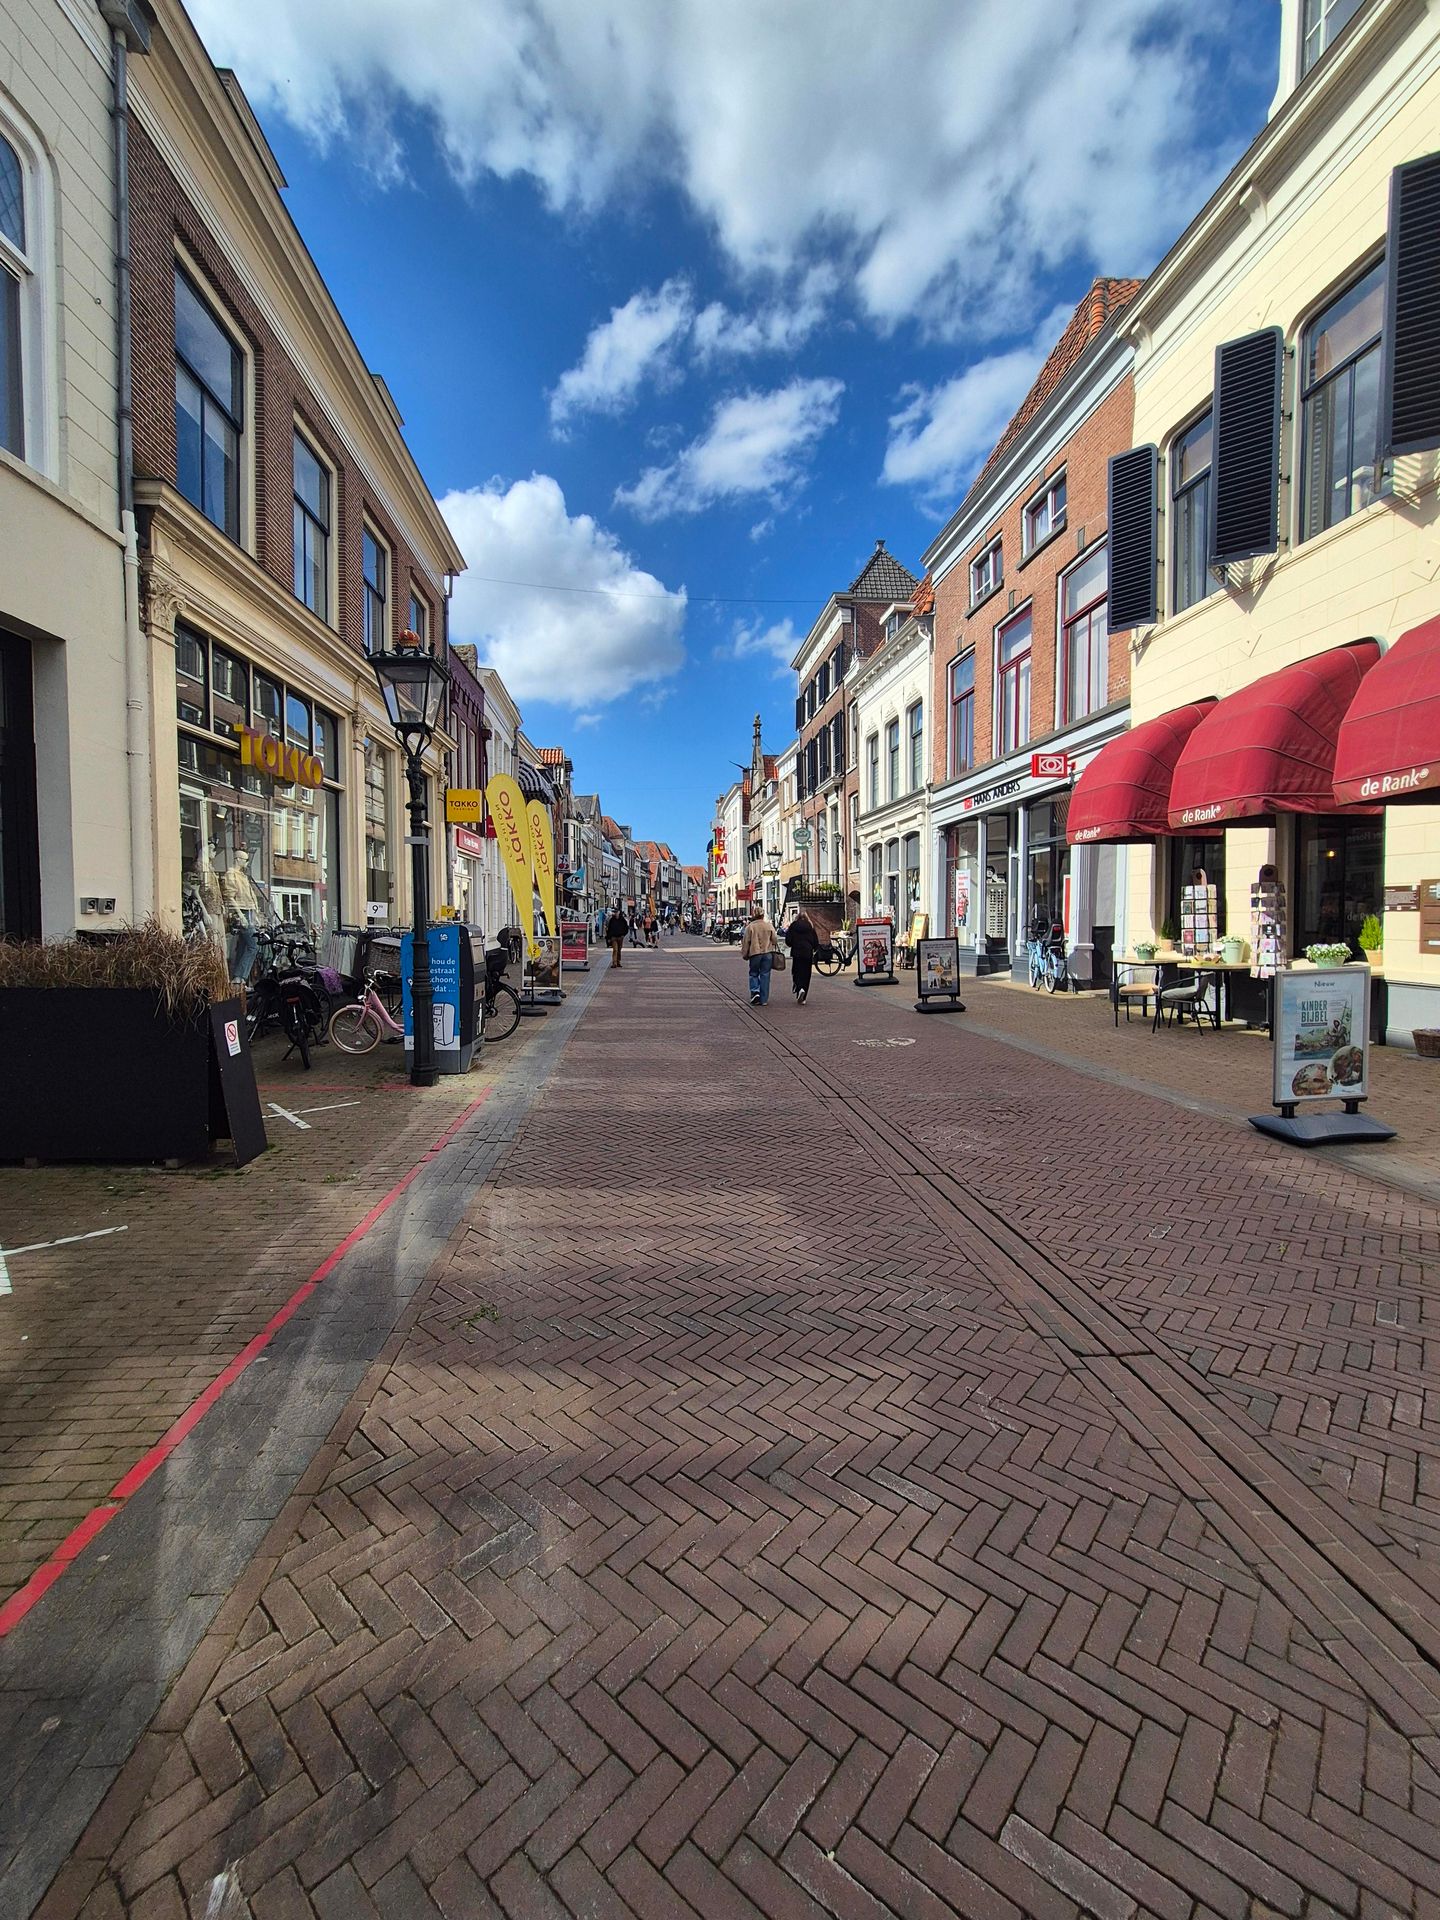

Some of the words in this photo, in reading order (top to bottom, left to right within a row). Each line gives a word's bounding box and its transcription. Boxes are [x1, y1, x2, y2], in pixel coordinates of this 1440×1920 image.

[233, 723, 324, 789] TAKKO
[1361, 778, 1380, 796] de
[1382, 768, 1420, 792] Rank
[973, 793, 991, 806] HANS
[992, 780, 1020, 800] ANDERS
[449, 800, 479, 808] TAKKO
[1182, 810, 1193, 823] de
[1194, 804, 1217, 822] Rank
[499, 791, 526, 866] TAKKO
[1075, 829, 1083, 840] de
[1083, 826, 1098, 840] Rank
[715, 826, 728, 878] HEMA
[431, 957, 446, 965] hou
[446, 957, 456, 965] de
[430, 976, 456, 984] choon,
[1301, 1000, 1328, 1011] KINDER
[1301, 1011, 1328, 1023] BIJBEL
